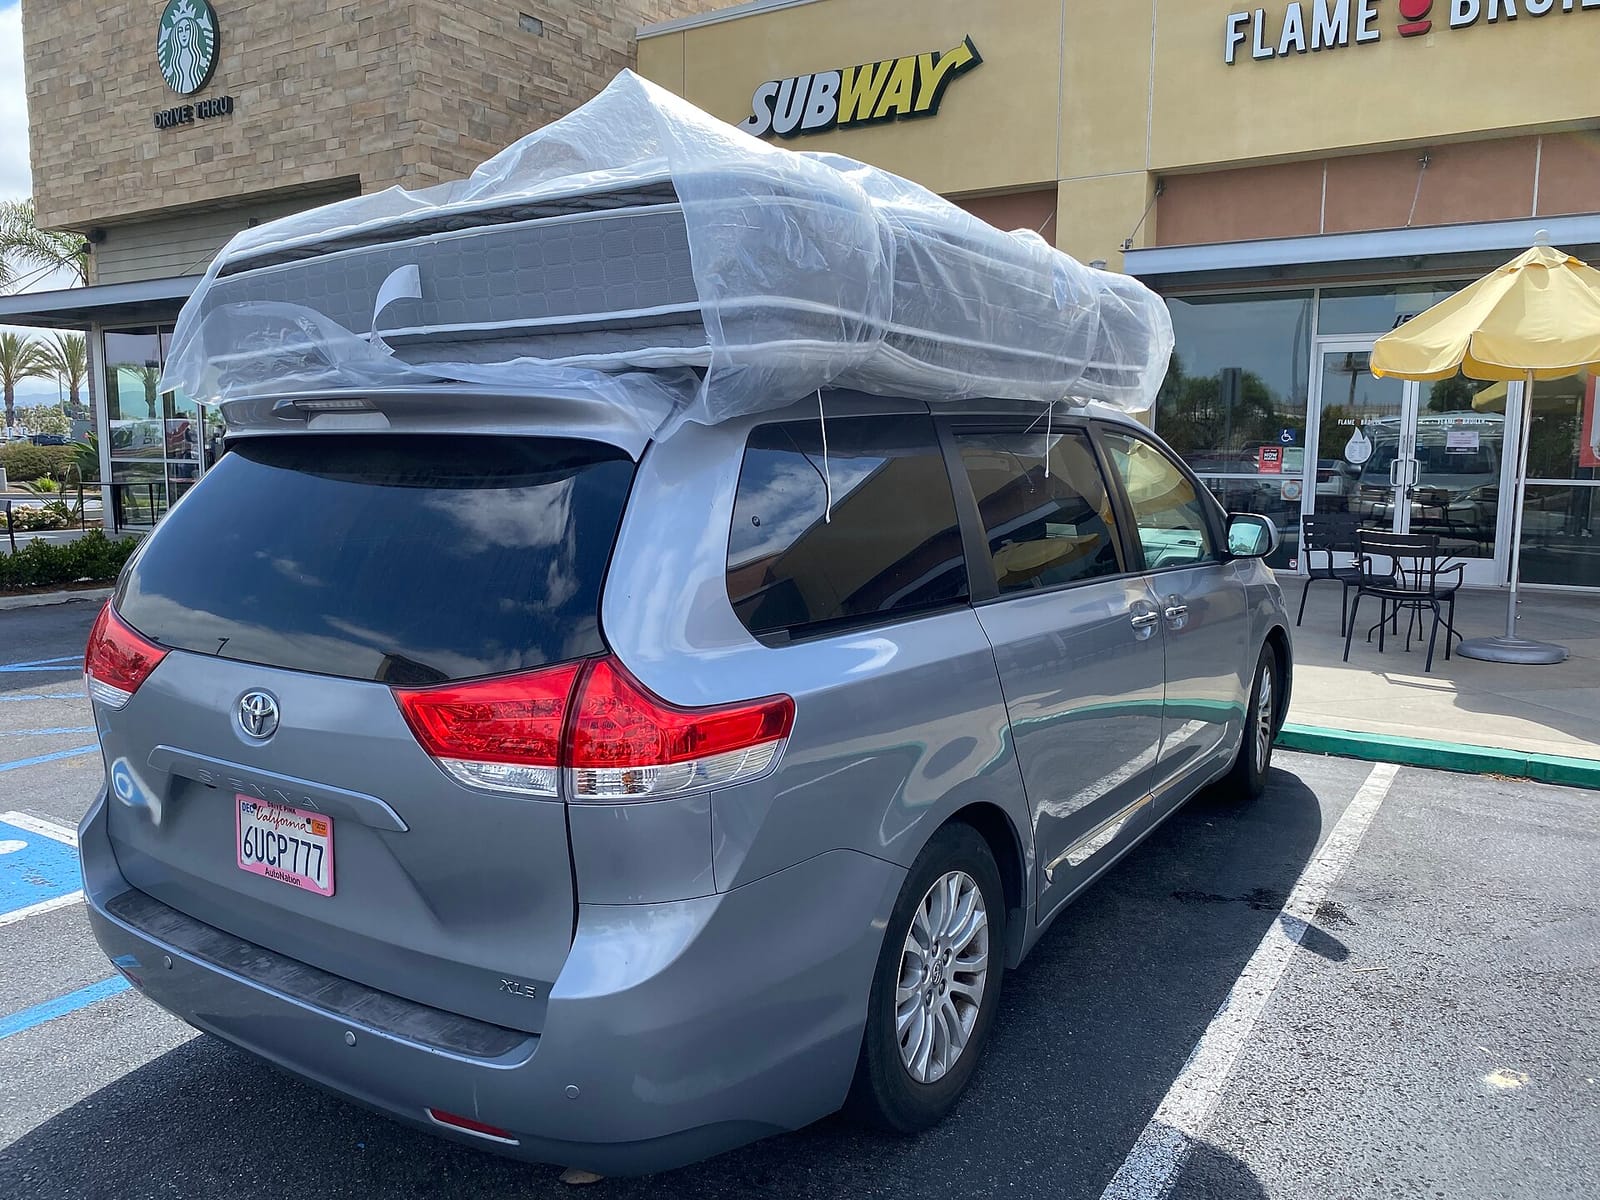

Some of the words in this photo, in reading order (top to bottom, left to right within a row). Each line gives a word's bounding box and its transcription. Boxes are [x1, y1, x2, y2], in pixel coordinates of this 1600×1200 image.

[1225, 0, 1381, 65] FLAME
[735, 39, 980, 138] SUBWAY
[154, 105, 193, 128] DRIVE
[194, 97, 232, 118] THRU
[256, 805, 310, 832] California
[243, 825, 324, 881] 6UCP777
[499, 979, 536, 998] XLE
